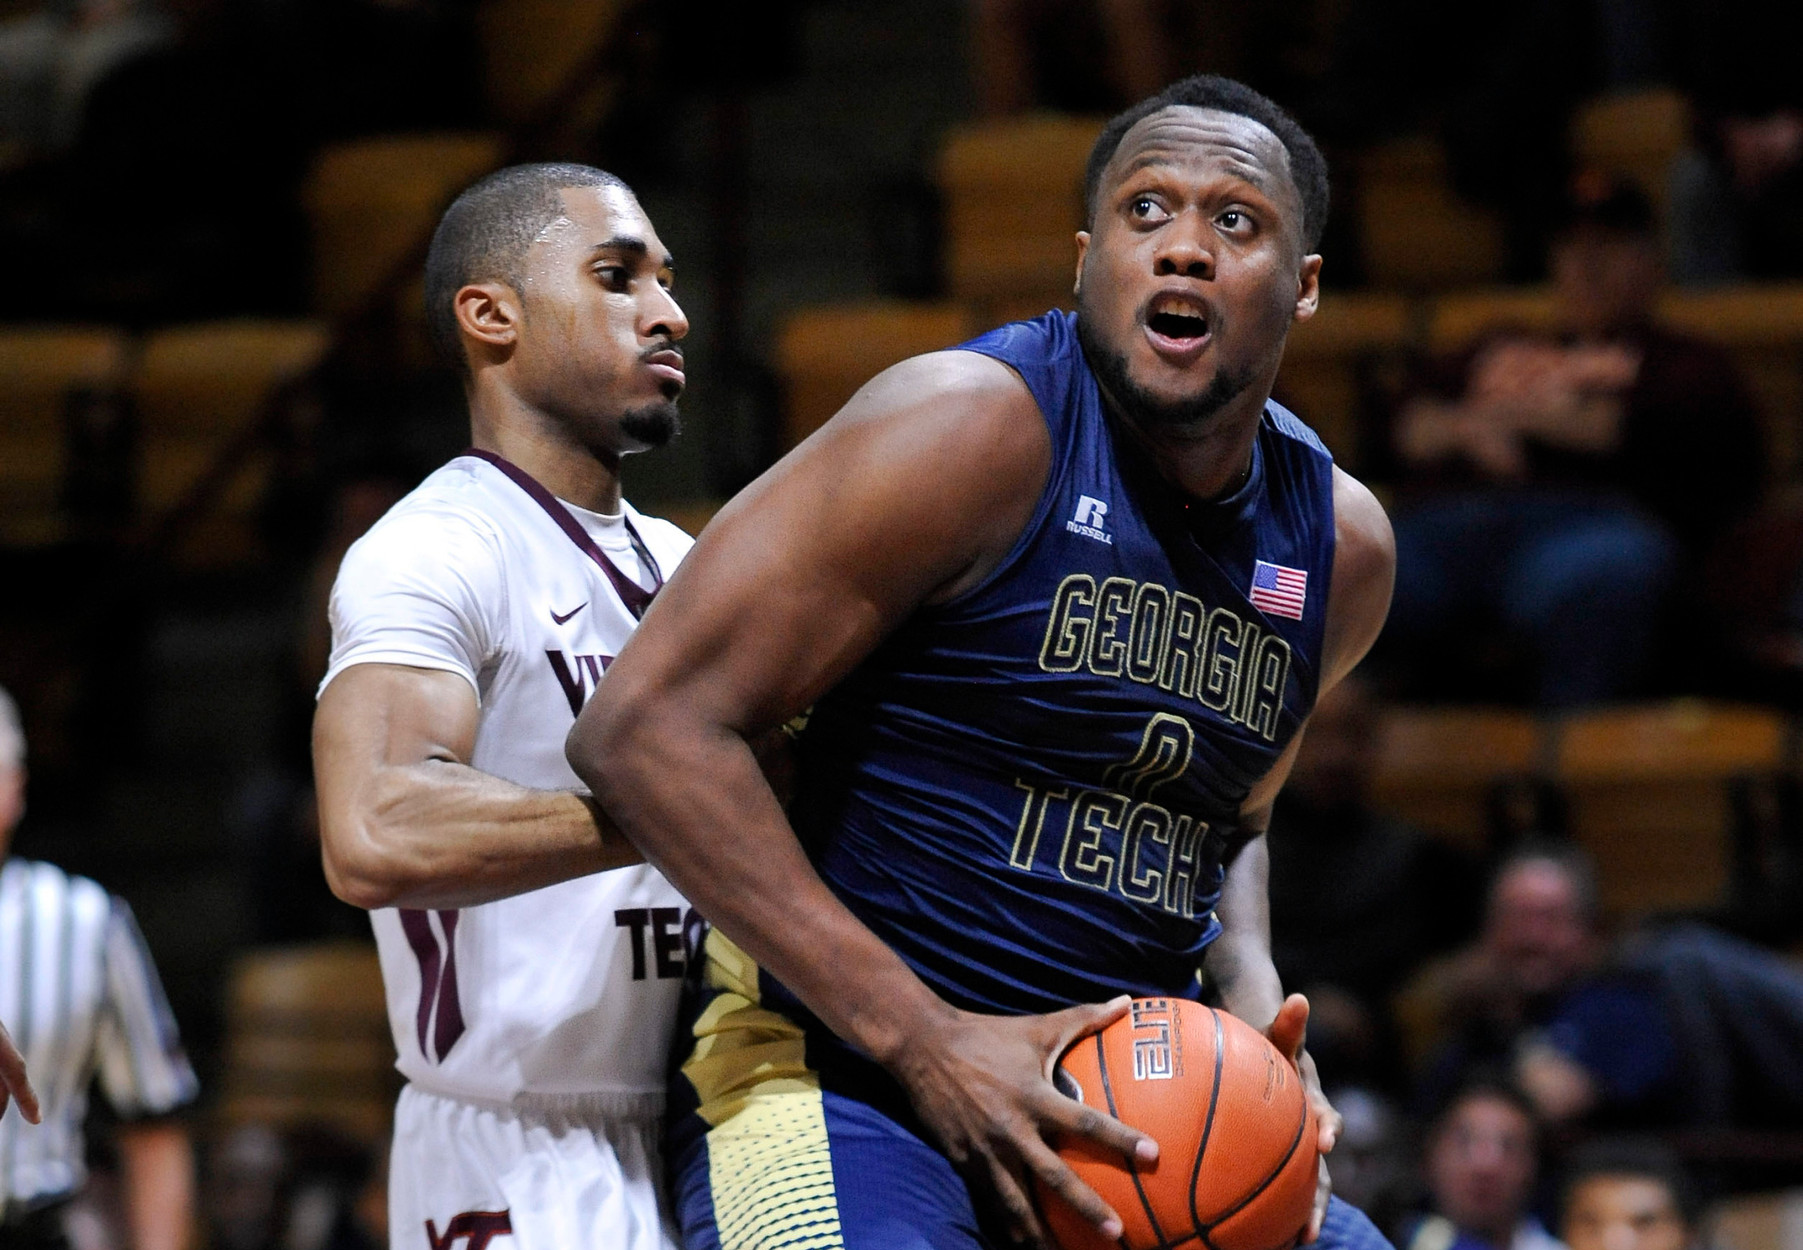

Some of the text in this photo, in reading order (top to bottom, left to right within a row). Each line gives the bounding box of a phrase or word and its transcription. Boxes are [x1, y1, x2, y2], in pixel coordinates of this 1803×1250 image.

[1066, 520, 1113, 545] RUSSELL
[1038, 573, 1292, 742] GEORGIA
[1008, 772, 1210, 920] TECH
